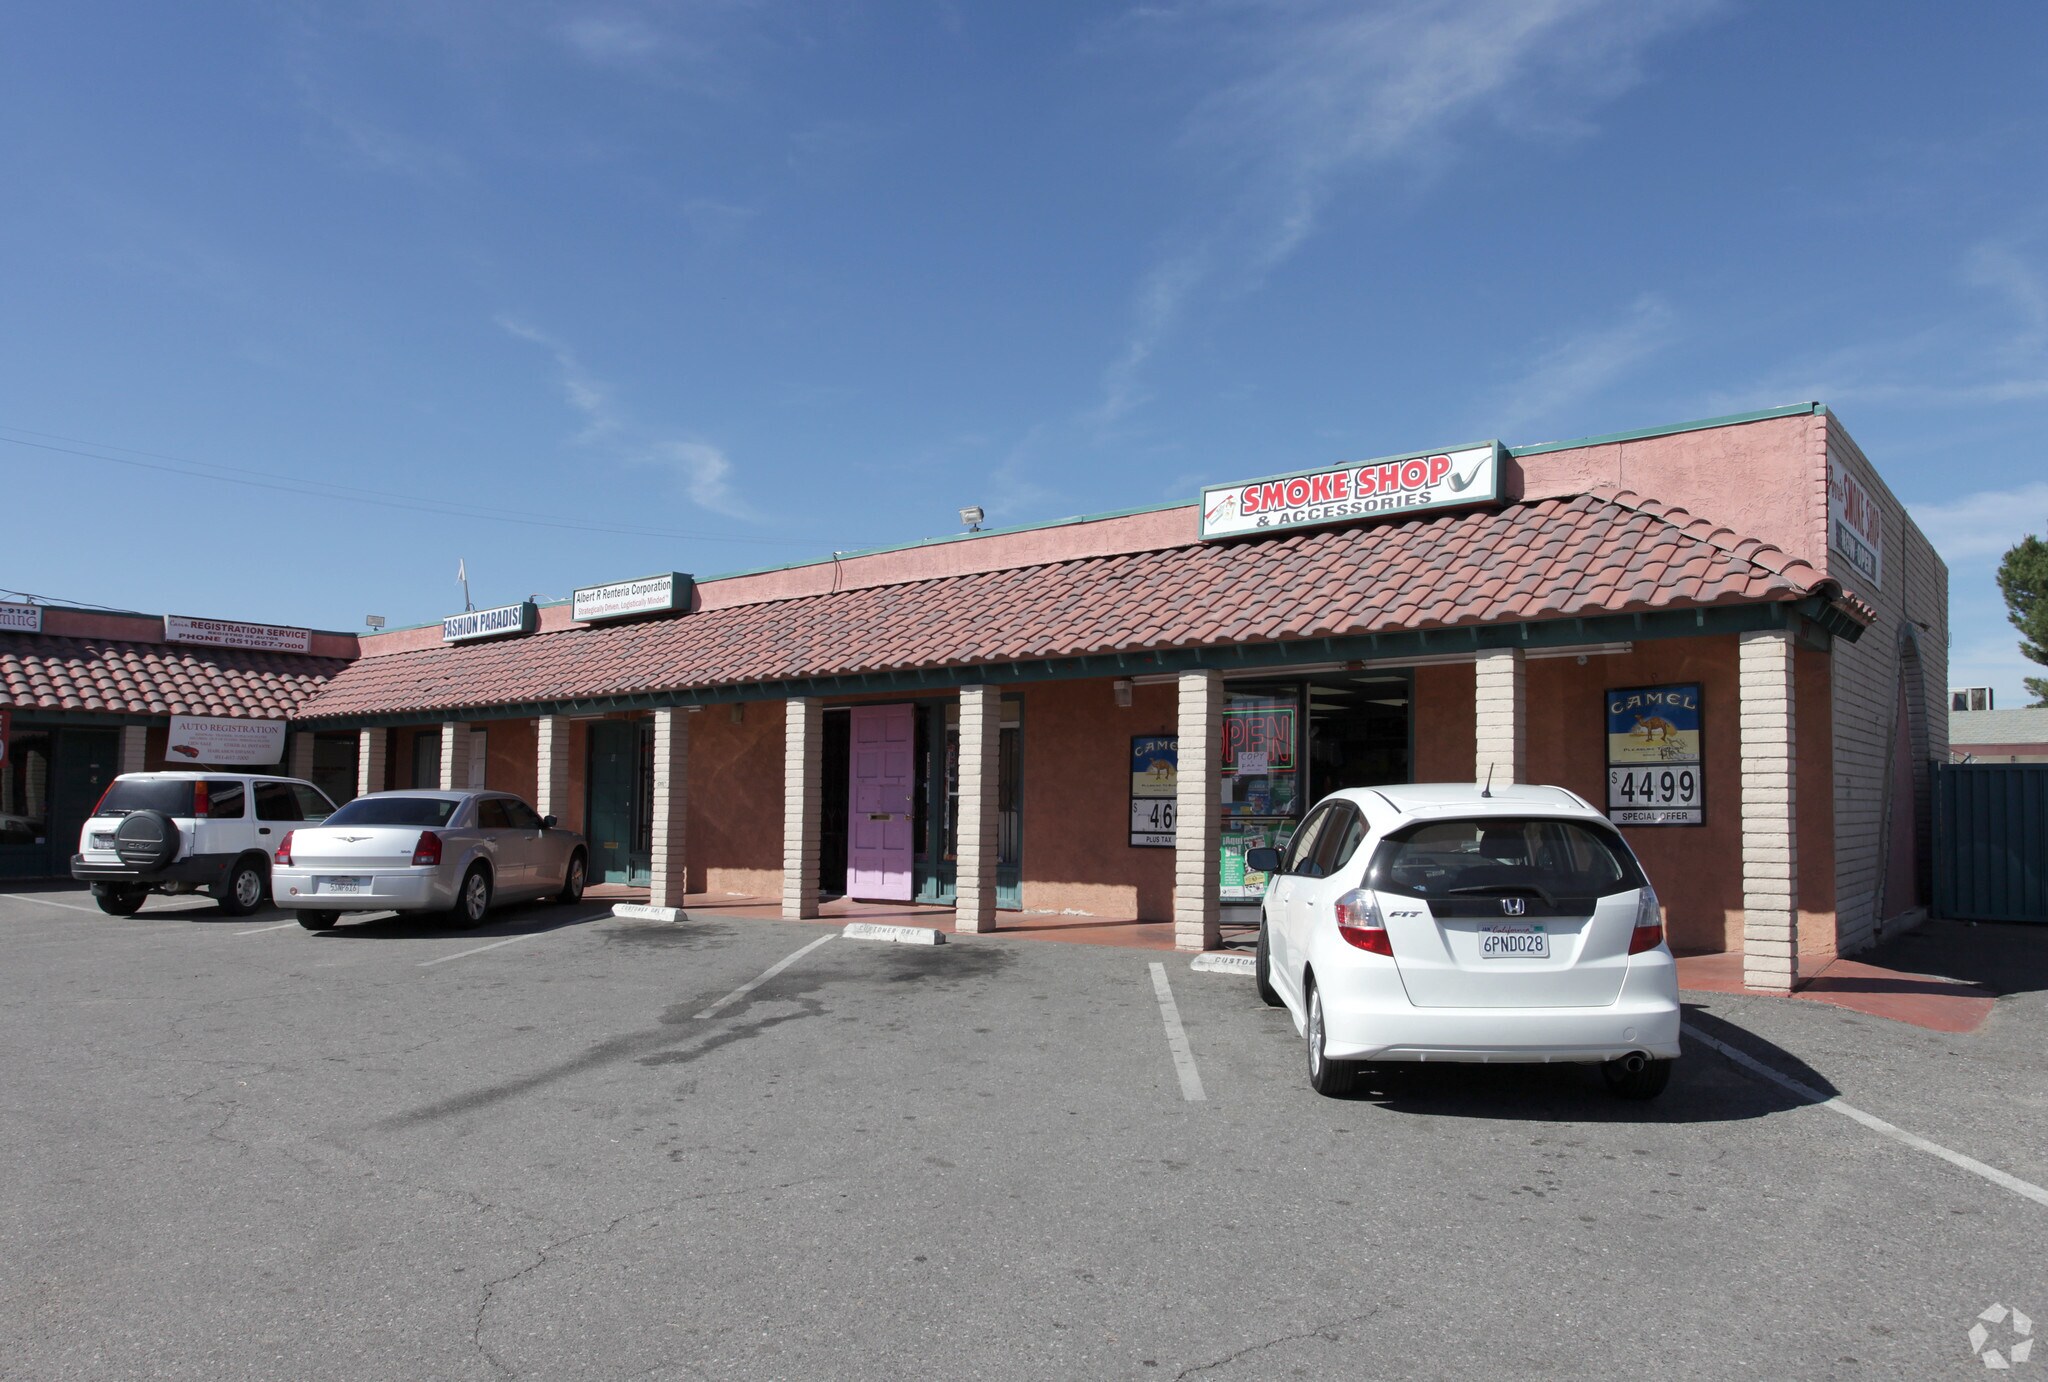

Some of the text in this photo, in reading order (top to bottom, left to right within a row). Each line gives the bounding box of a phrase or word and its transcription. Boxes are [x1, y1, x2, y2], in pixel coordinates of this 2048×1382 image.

[1241, 453, 1453, 517] SMOKE SHOP
[1256, 491, 1432, 528] & ACCESSORIES
[1844, 472, 1864, 537] SMOKE
[576, 579, 671, 603] Albert R Renteria Corporation
[190, 620, 264, 635] REGISTRATION
[266, 629, 307, 639] SERVICE
[443, 615, 478, 638] FASHION
[178, 633, 221, 642] PHONE
[1611, 693, 1696, 714] CAMEL
[179, 722, 280, 734] AUTO REGISTRATION
[1134, 741, 1178, 757] CAME
[1241, 752, 1265, 761] COPY
[1150, 803, 1177, 829] 4.6
[1622, 811, 1688, 821] SPECIAL OFFER
[858, 924, 897, 934] CUSTOMER
[1492, 925, 1530, 933] California
[1484, 935, 1543, 952] 6PND028
[1215, 956, 1257, 966] CUSTOM
